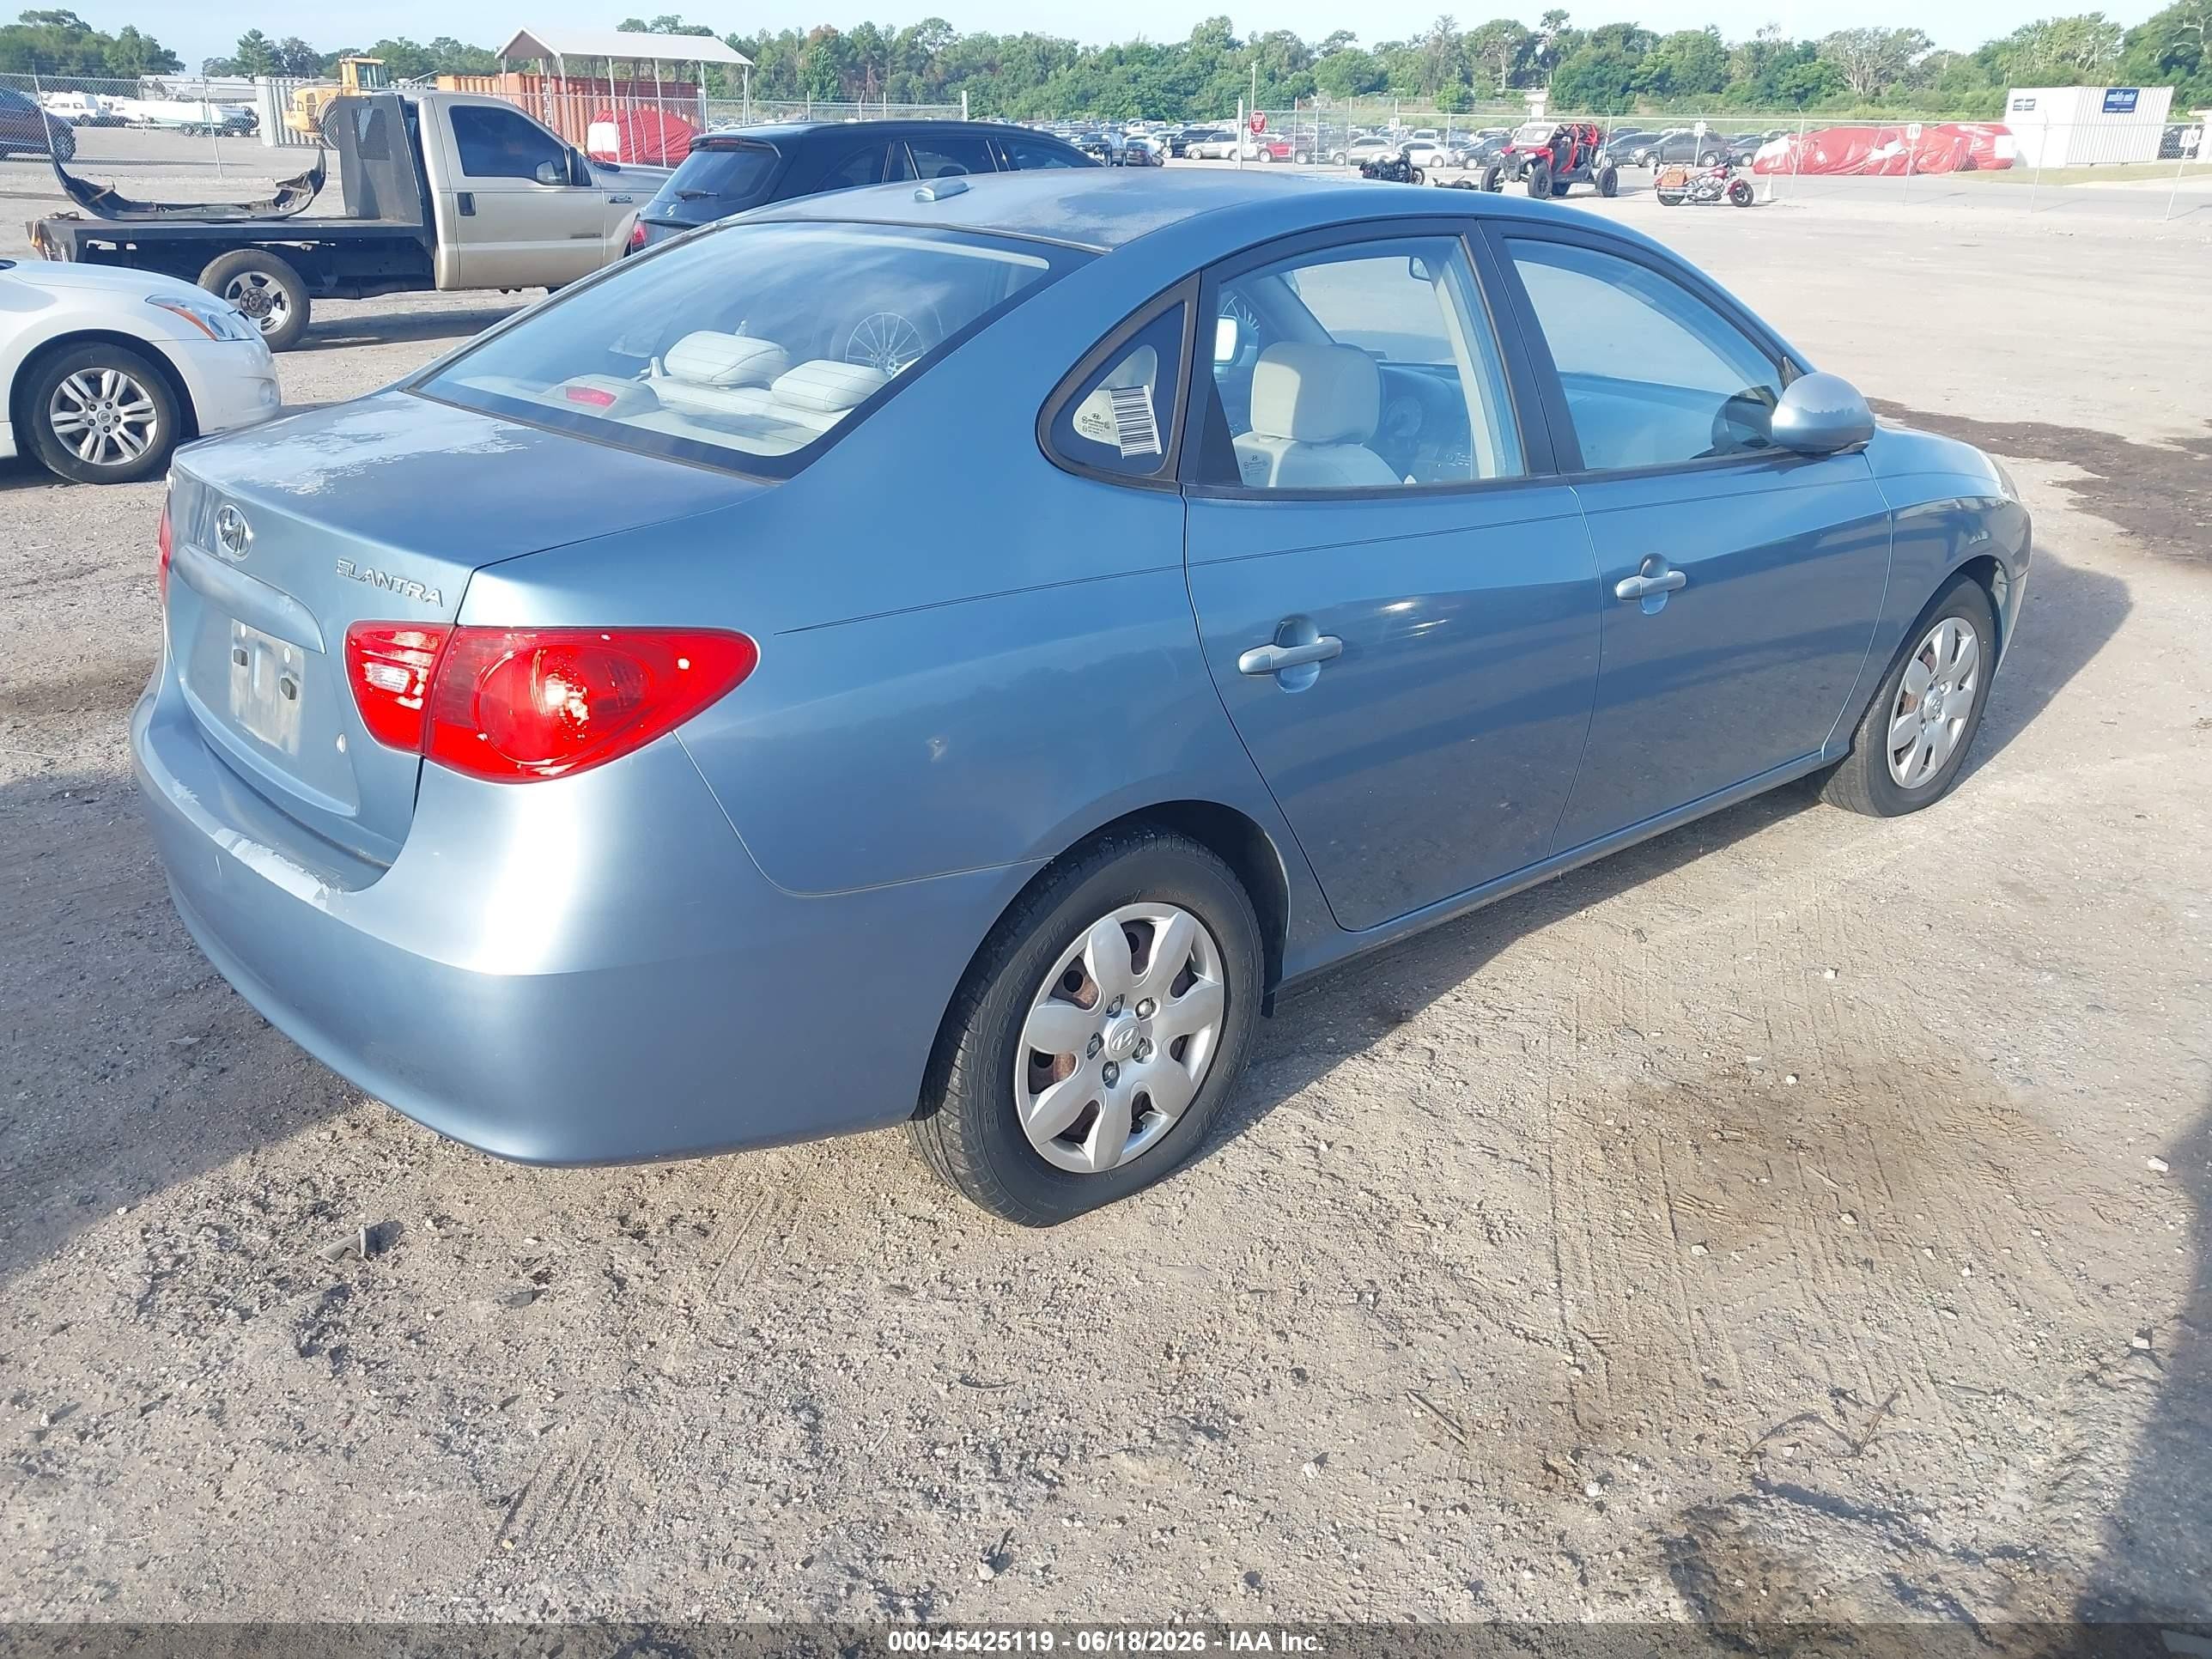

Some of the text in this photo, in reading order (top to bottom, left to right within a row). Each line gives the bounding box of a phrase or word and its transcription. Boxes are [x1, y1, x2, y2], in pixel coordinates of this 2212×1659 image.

[1252, 114, 1265, 123] STOP
[1910, 125, 1920, 137] 19
[337, 558, 444, 608] ELANTRA
